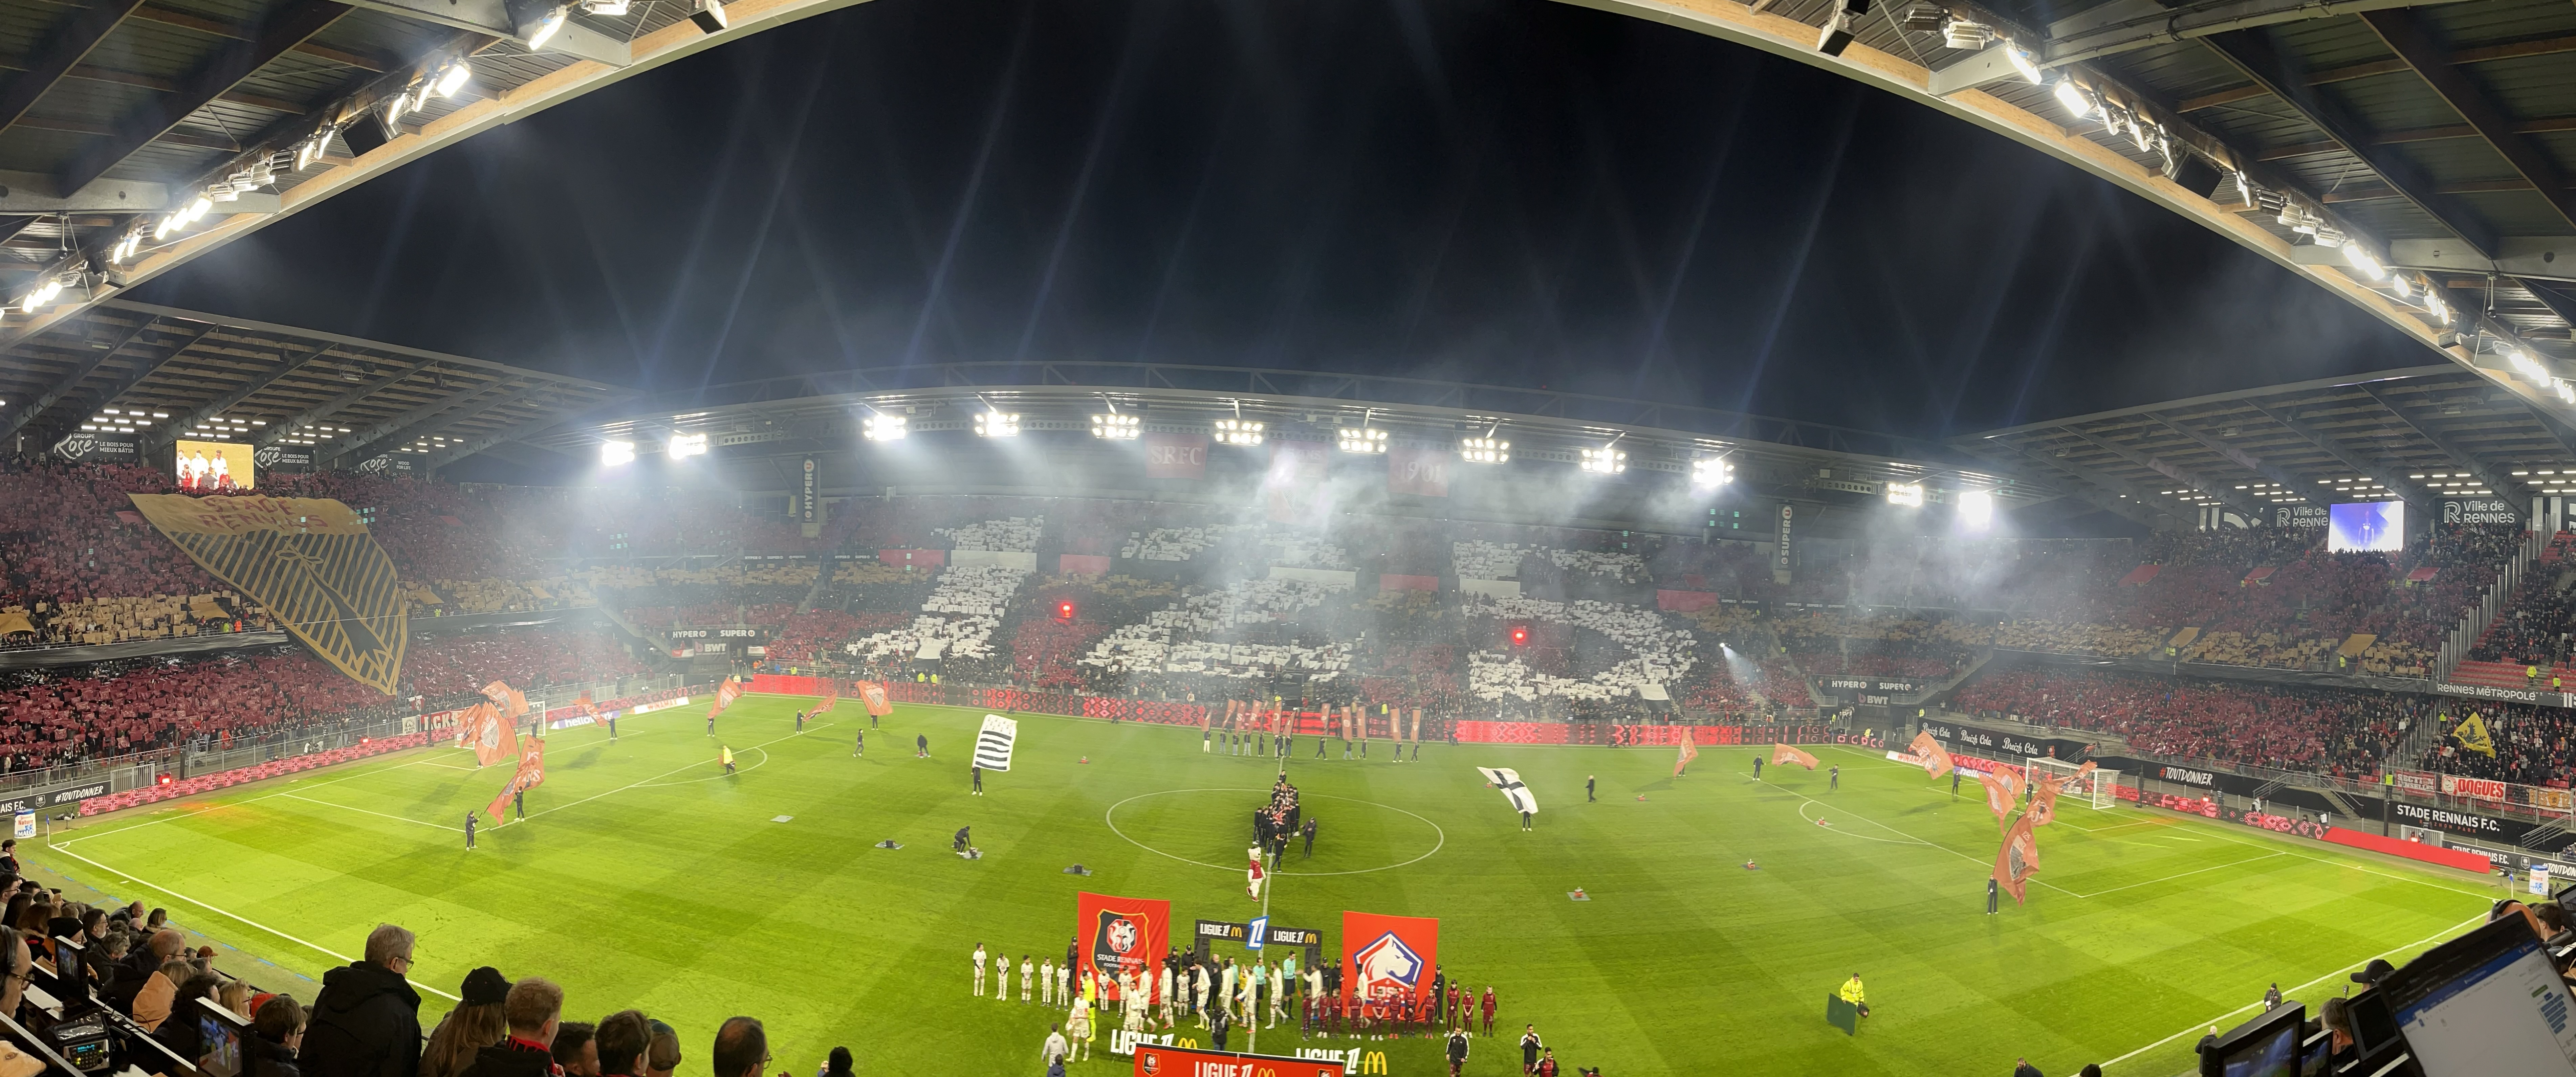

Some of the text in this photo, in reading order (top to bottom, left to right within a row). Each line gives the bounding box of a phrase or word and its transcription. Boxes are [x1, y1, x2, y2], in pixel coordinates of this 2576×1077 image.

[54, 433, 95, 459] Rose
[1151, 446, 1203, 466] SRFC
[1399, 461, 1442, 483] 1901
[804, 473, 813, 509] HYPER
[204, 498, 296, 515] STADE
[2293, 507, 2327, 516] Ville de
[2463, 501, 2505, 511] Ville de
[2293, 517, 2328, 527] RENNE
[1782, 520, 1791, 556] SUPER
[704, 643, 726, 652] BWT
[1879, 682, 1904, 691] SUPER
[1867, 695, 1888, 704] BWT
[565, 711, 614, 727] hellork
[1939, 727, 1950, 738] Cola
[1961, 730, 1991, 746] Breizh Cola
[2003, 737, 2038, 755] Breizh Cola
[1898, 753, 1924, 765] WINAMA
[2159, 767, 2213, 786] #TOUTDONNER
[55, 786, 104, 803] #TOUTDONNER
[2458, 779, 2504, 798] DOGUES
[0, 801, 26, 813] AIS F.C.
[2397, 804, 2500, 831] STADE RENNAIS F.C.
[2499, 854, 2509, 864] F.C.
[1200, 923, 1222, 936] LIGUE
[1274, 930, 1296, 943] LIGUE
[1097, 954, 1117, 962] STADE
